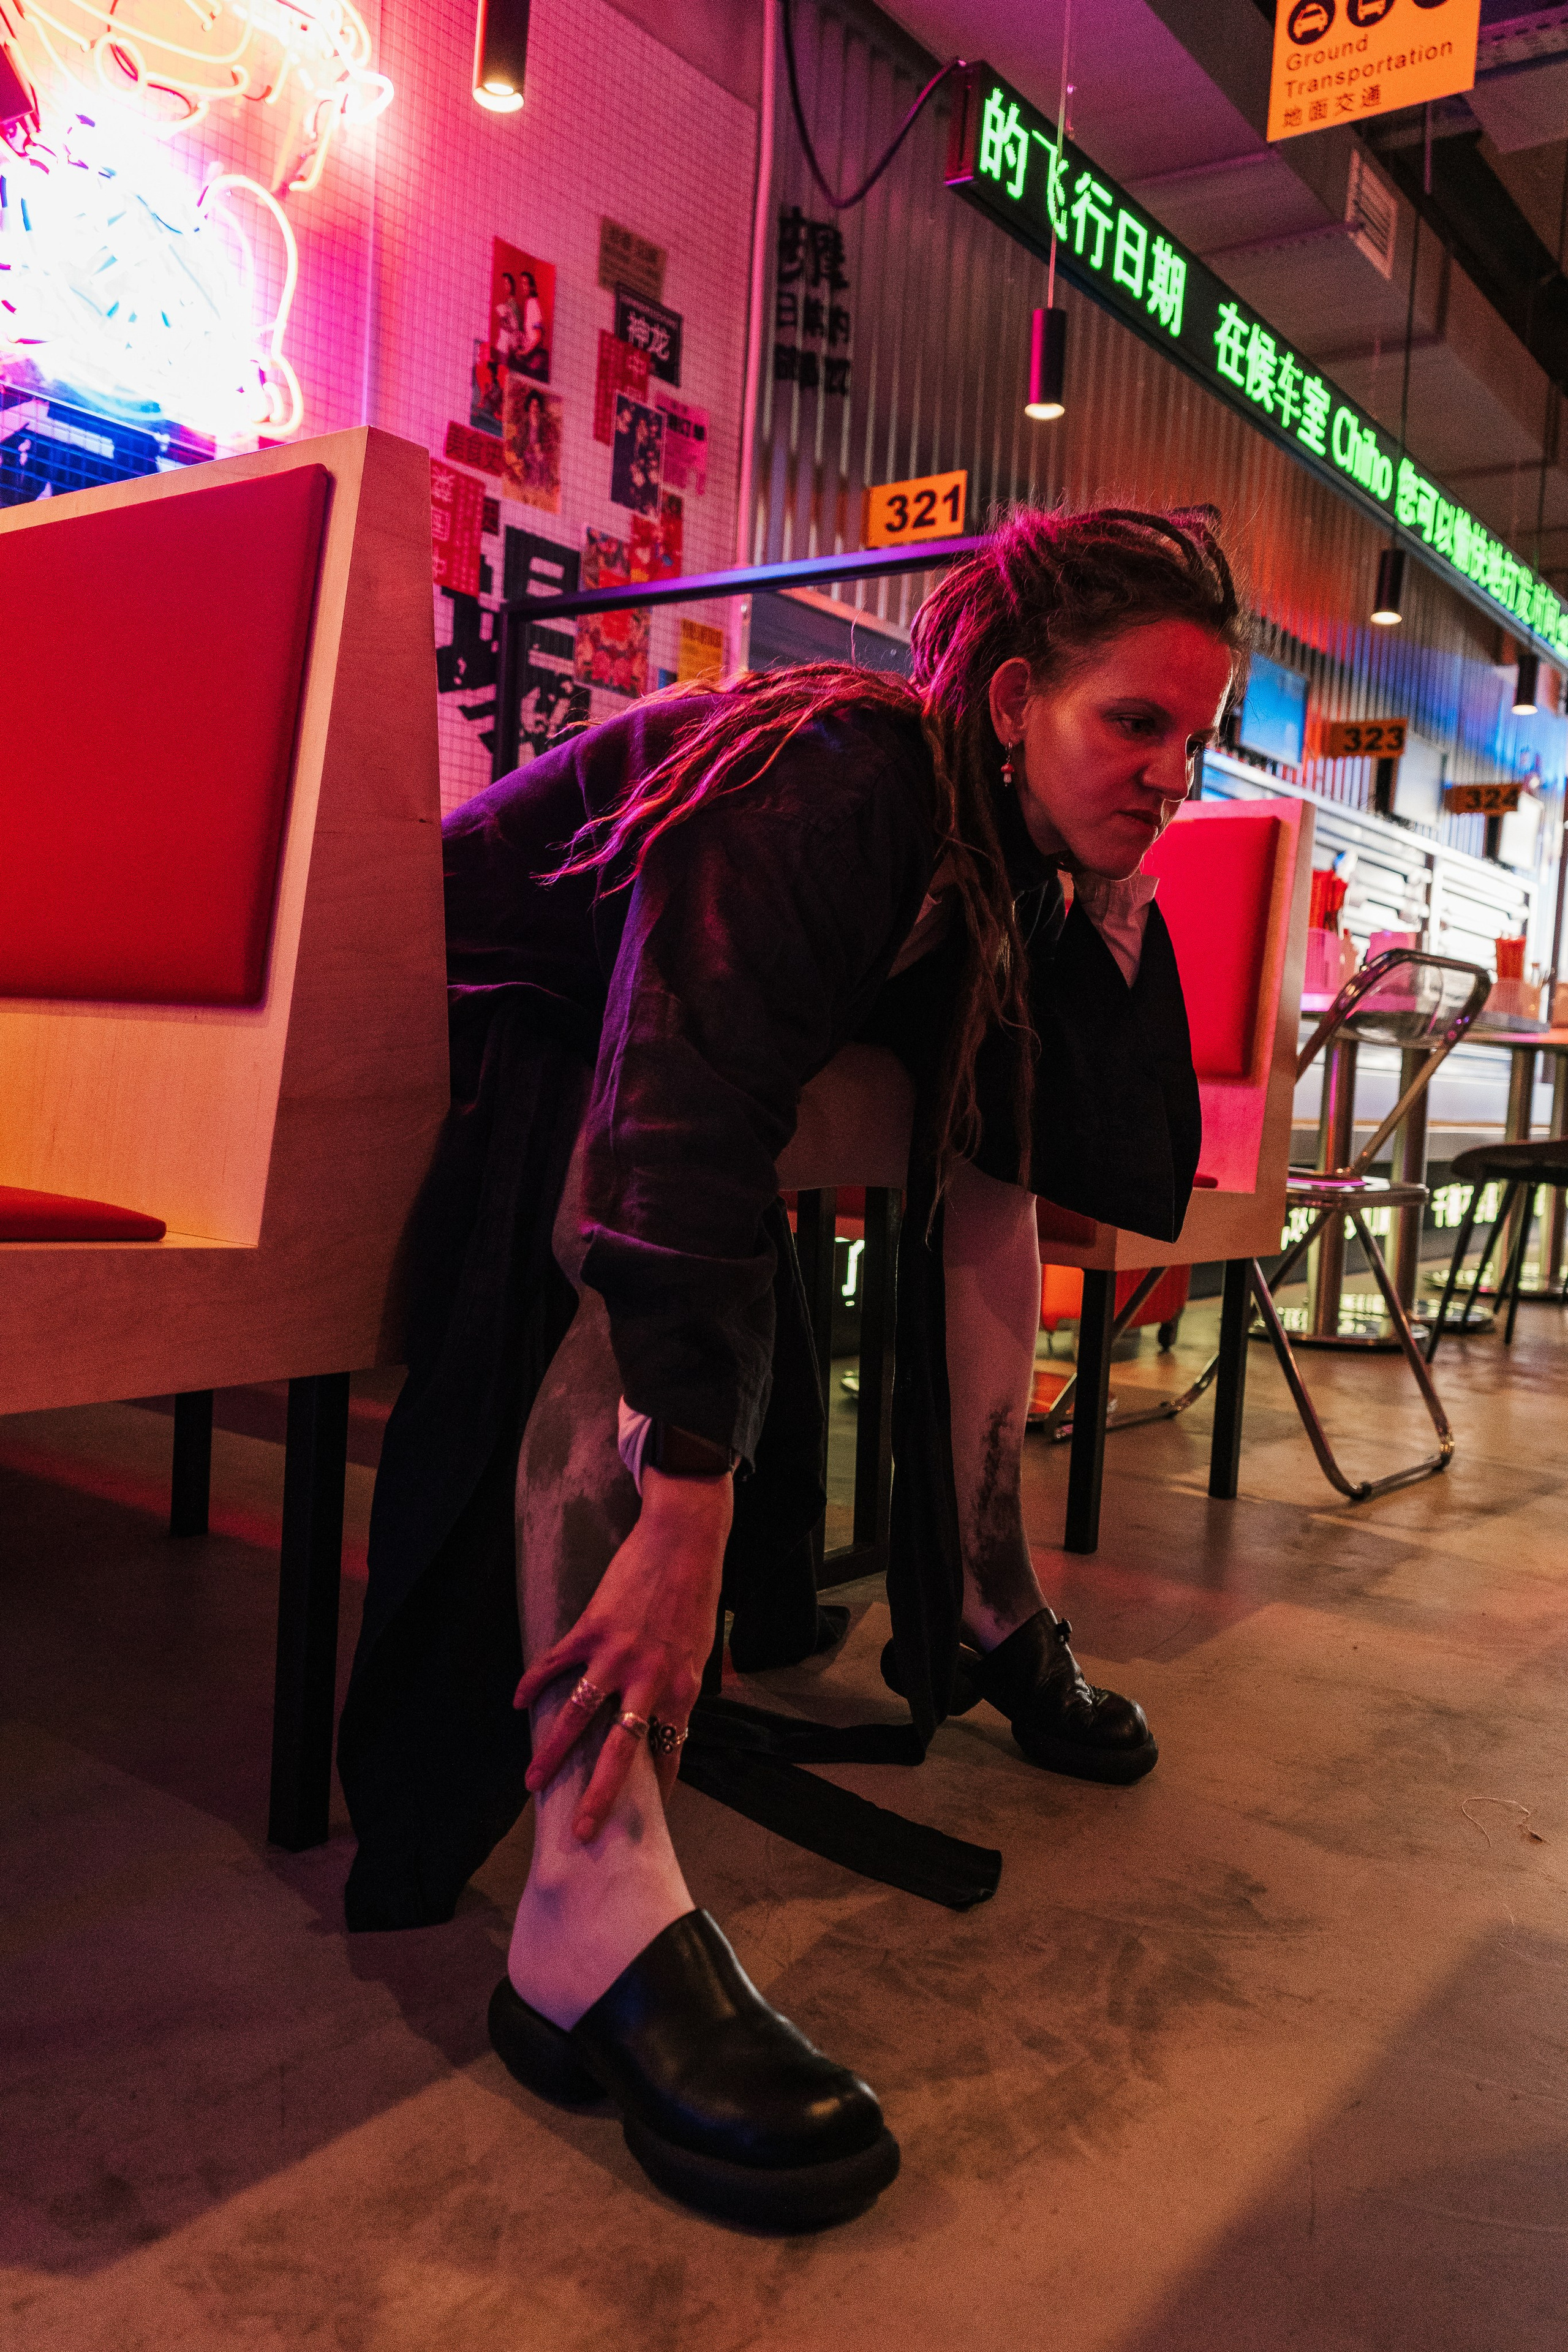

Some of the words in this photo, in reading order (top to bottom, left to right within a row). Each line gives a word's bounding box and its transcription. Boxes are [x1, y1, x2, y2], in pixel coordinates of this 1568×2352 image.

[1284, 40, 1453, 98] Transportation
[1286, 34, 1370, 72] Ground
[1283, 85, 1382, 128] 地面交通
[979, 88, 1187, 337] 的飞行日期
[1213, 302, 1332, 457] 在候车室
[885, 484, 961, 532] 321
[1344, 725, 1406, 752] 323
